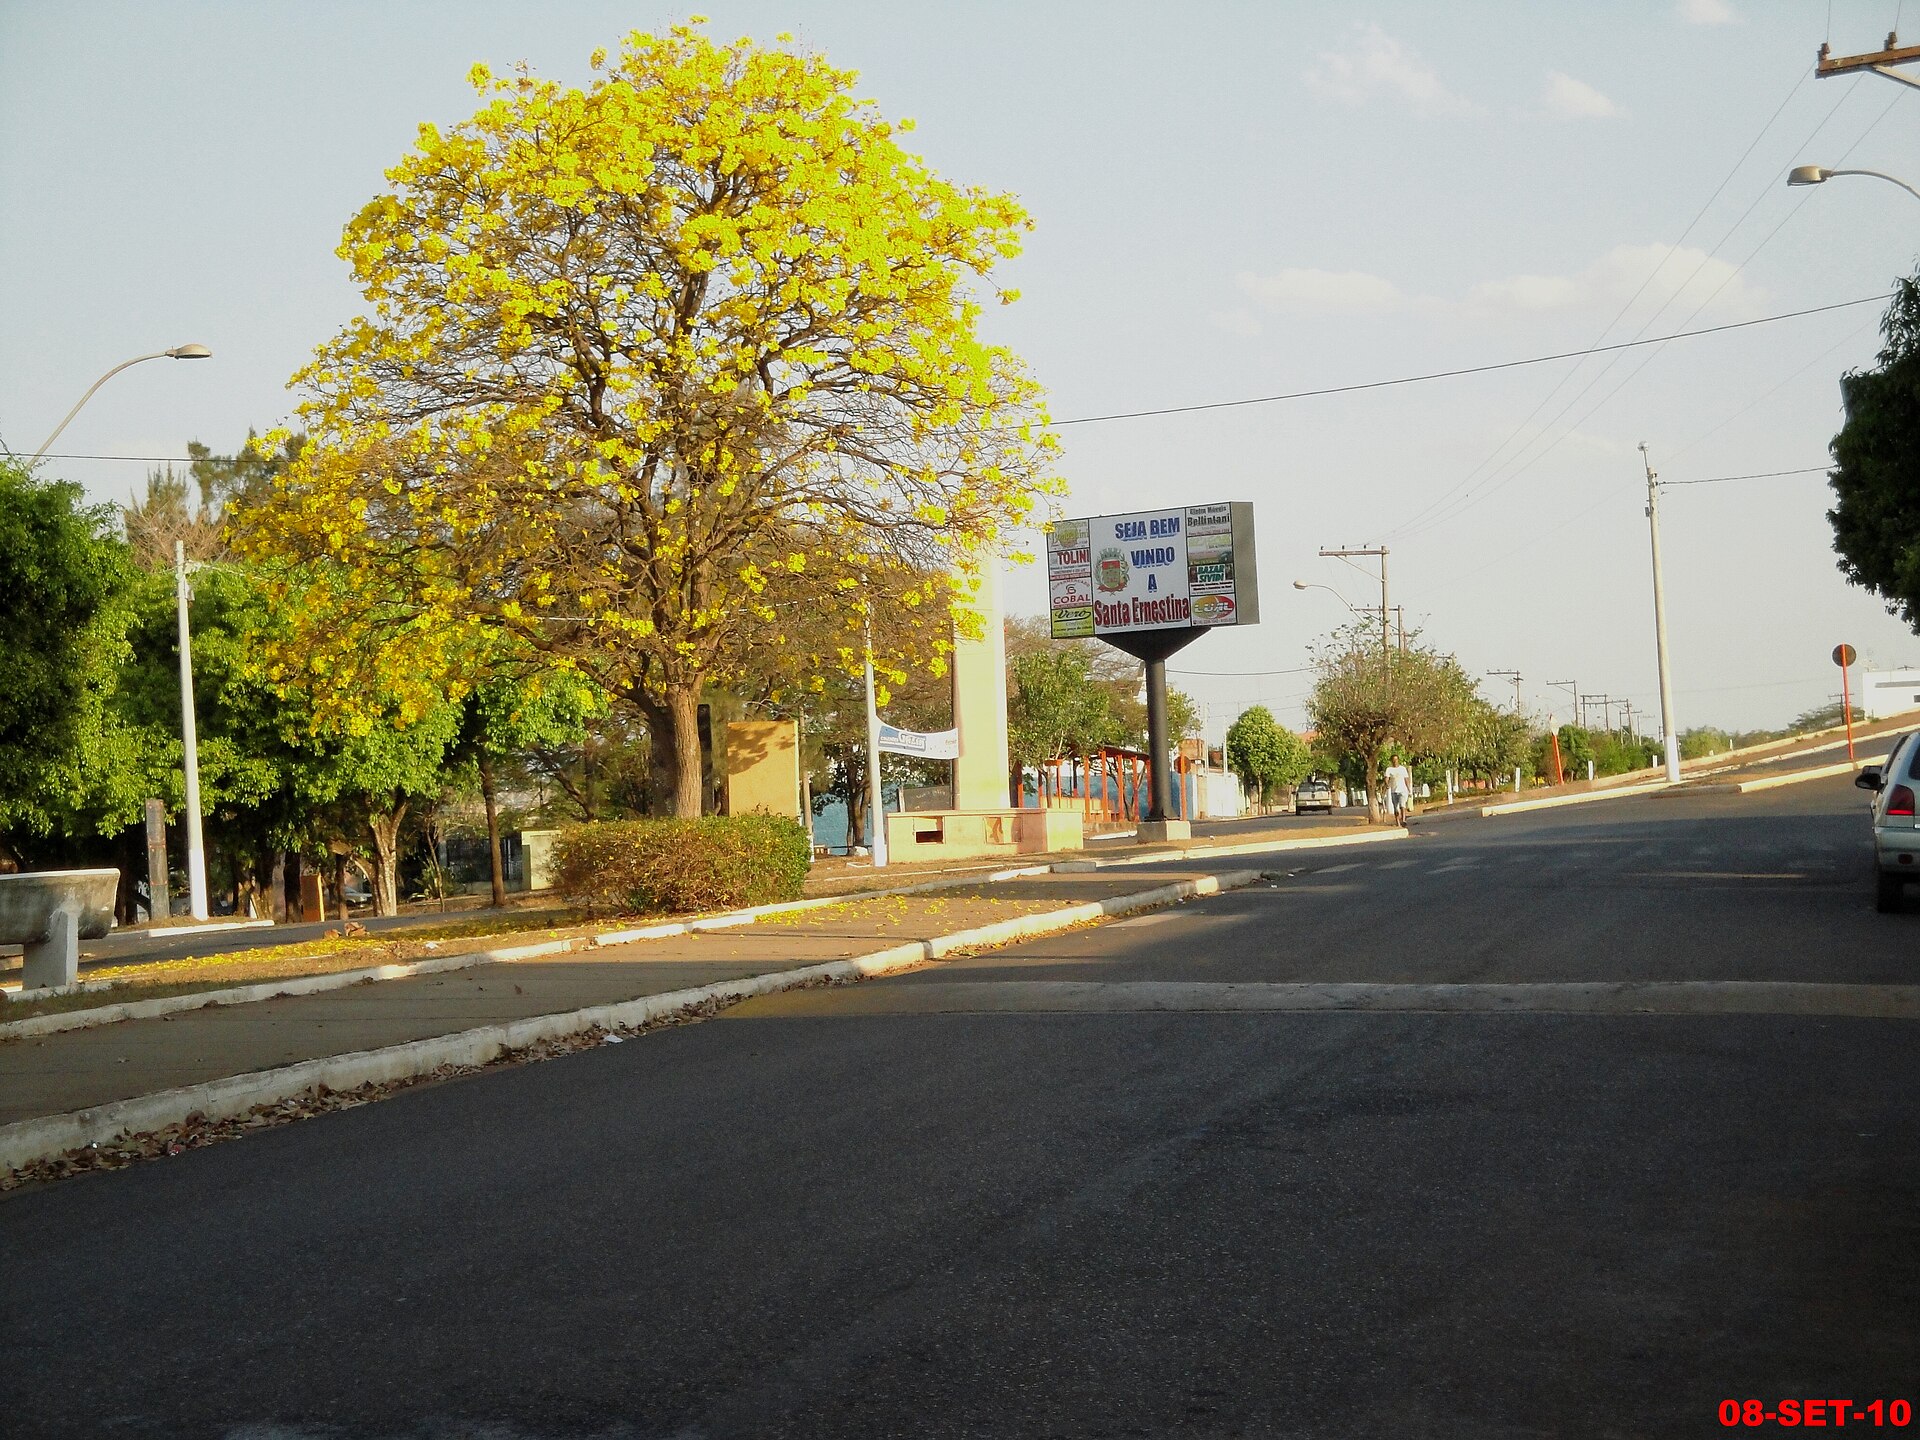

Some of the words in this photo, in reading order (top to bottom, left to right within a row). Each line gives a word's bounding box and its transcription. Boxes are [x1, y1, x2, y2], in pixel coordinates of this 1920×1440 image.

[1115, 520, 1147, 540] SEJA
[1150, 517, 1180, 538] BEM
[1187, 513, 1230, 527] Bellintani
[1057, 549, 1090, 565] TOLINI
[1131, 546, 1175, 567] VINDO
[1198, 564, 1225, 574] BAZAR
[1147, 573, 1158, 591] A
[1053, 594, 1091, 604] COBAL
[1094, 600, 1131, 626] Santa
[1131, 594, 1190, 623] Ernestina
